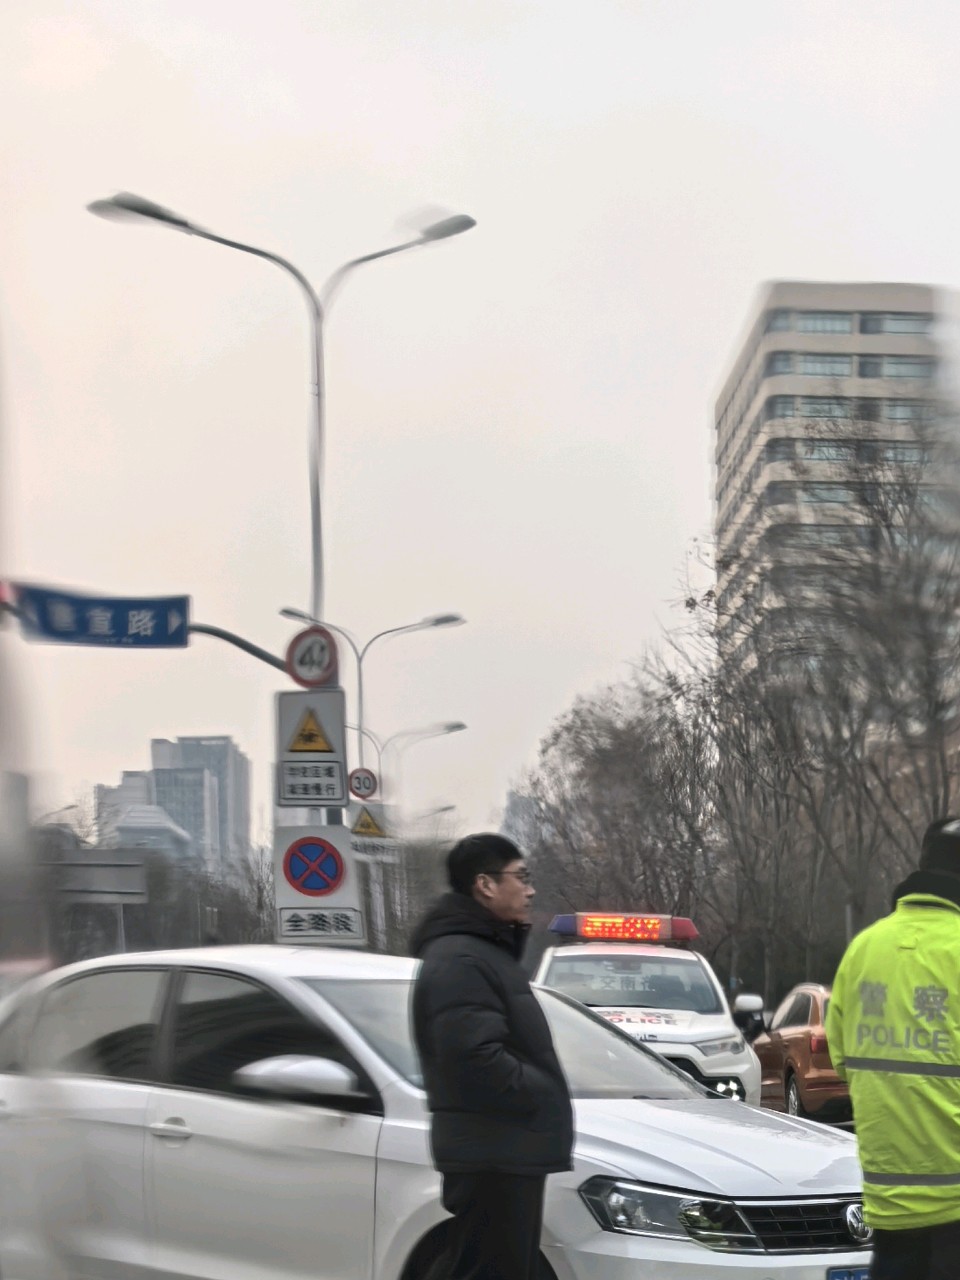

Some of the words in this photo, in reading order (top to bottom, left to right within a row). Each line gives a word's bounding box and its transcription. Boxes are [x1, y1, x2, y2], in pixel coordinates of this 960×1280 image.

[354, 776, 371, 790] 30
[285, 912, 355, 933] 全路段
[607, 1016, 678, 1025] OLICE
[856, 1024, 950, 1054] POLICE
